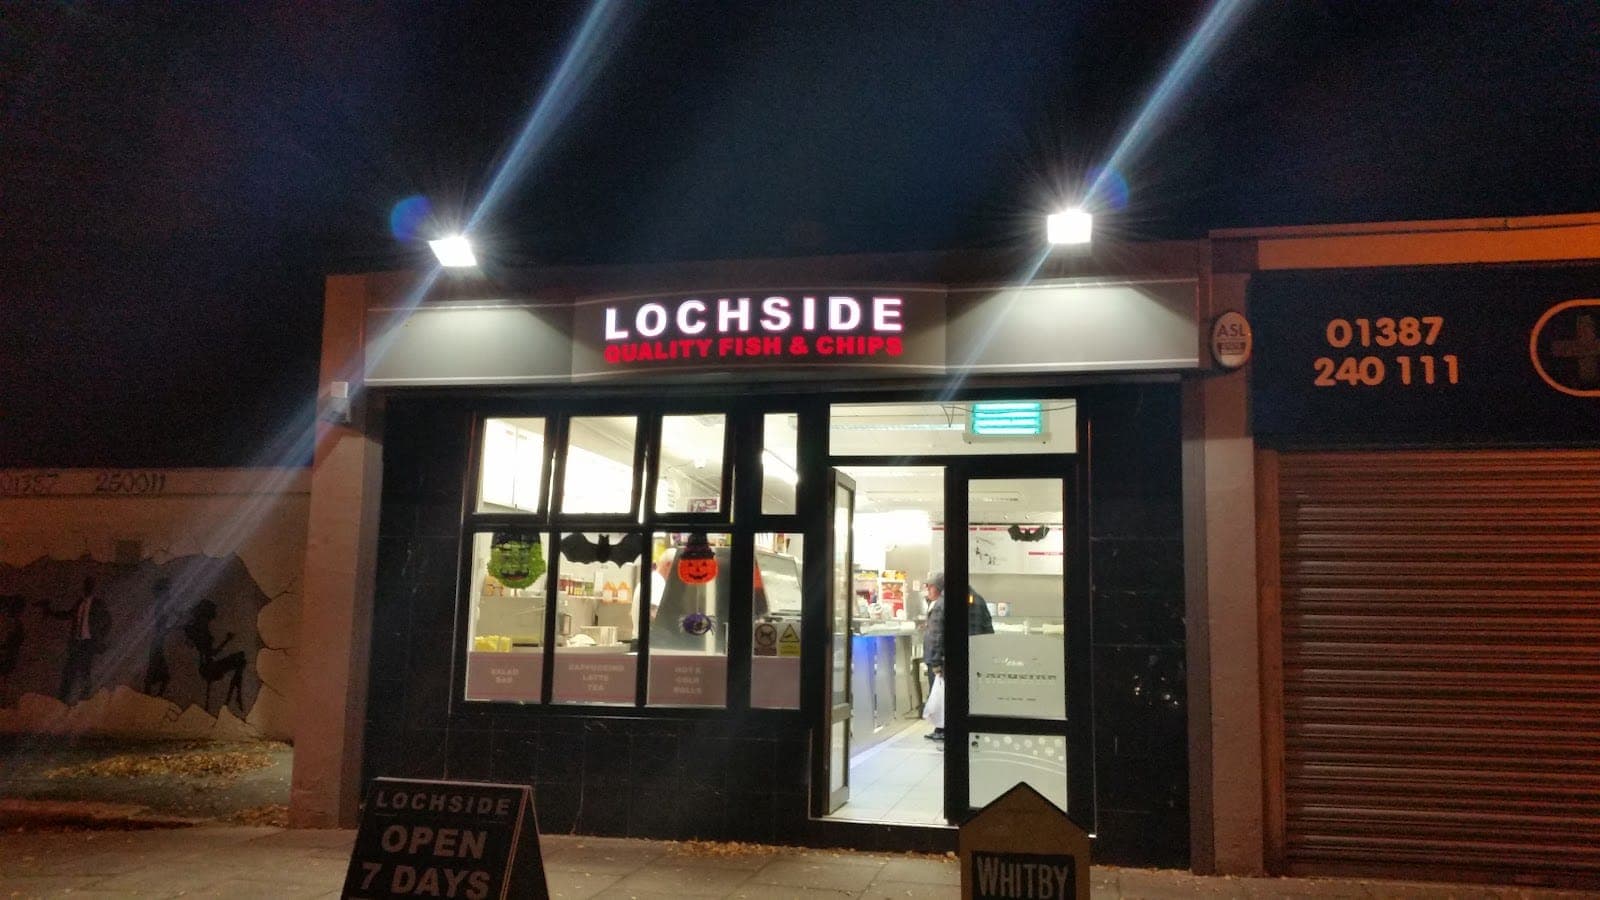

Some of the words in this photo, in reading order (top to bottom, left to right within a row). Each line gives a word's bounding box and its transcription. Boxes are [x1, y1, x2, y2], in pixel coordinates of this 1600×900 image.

[605, 296, 903, 341] LOCHSIDE
[1216, 323, 1247, 337] ASL
[1326, 316, 1444, 348] 01387
[604, 339, 712, 364] QUALITY
[718, 336, 782, 357] FISH
[790, 336, 808, 356] &
[816, 335, 904, 357] CHIPS
[1313, 355, 1386, 387] 240
[1396, 354, 1460, 385] 111
[375, 790, 512, 815] LOCHSIDE
[381, 824, 488, 860] OPEN
[361, 861, 382, 890] 7
[391, 865, 491, 900] DAYS
[976, 856, 1069, 900] WHITBY
